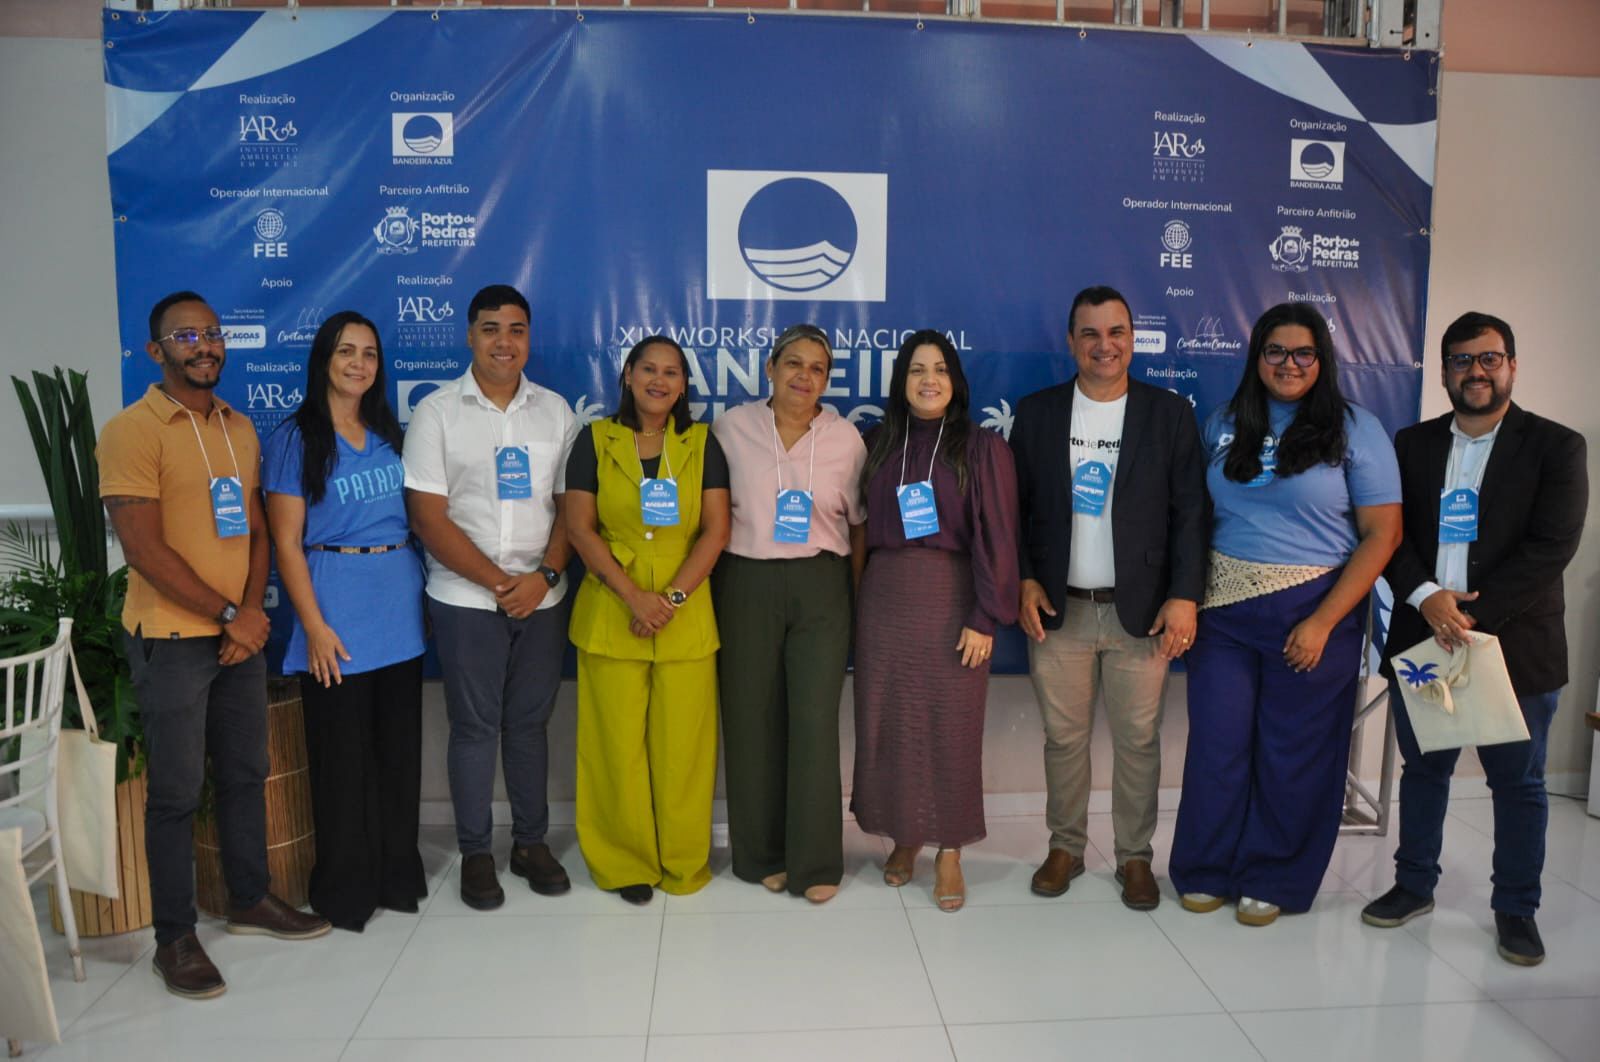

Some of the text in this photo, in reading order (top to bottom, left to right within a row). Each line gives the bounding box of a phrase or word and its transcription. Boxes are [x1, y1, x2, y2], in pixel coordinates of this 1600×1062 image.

[240, 94, 296, 105] Realização
[390, 90, 455, 103] Organização
[1154, 110, 1206, 124] Realização
[1290, 118, 1347, 133] Organização
[392, 157, 453, 165] BANDEIRA AZUL
[380, 184, 470, 196] Parceiro Anfitrião
[1290, 180, 1342, 190] BANDEIRA AZUL
[210, 186, 328, 199] Operador Internacional
[1122, 198, 1232, 212] Operador Internacional
[422, 212, 476, 225] Porto de
[1277, 206, 1356, 220] Parceiro Anfitrião
[422, 225, 476, 238] Pedras
[1313, 234, 1360, 248] Porto de
[253, 242, 288, 258] FEE
[1312, 247, 1360, 261] Pedras
[1160, 253, 1192, 268] FEE
[1312, 260, 1358, 269] PREFEITURA
[261, 278, 292, 289] Apoio
[397, 275, 453, 286] Realização
[1166, 286, 1194, 298] Apoio
[1288, 290, 1336, 304] Realização
[670, 326, 827, 347] WORKSH
[836, 328, 972, 350] NACIAL
[247, 363, 302, 374] Realização
[394, 359, 459, 371] Organização
[620, 347, 898, 396] ANEI
[1146, 368, 1198, 379] Realização
